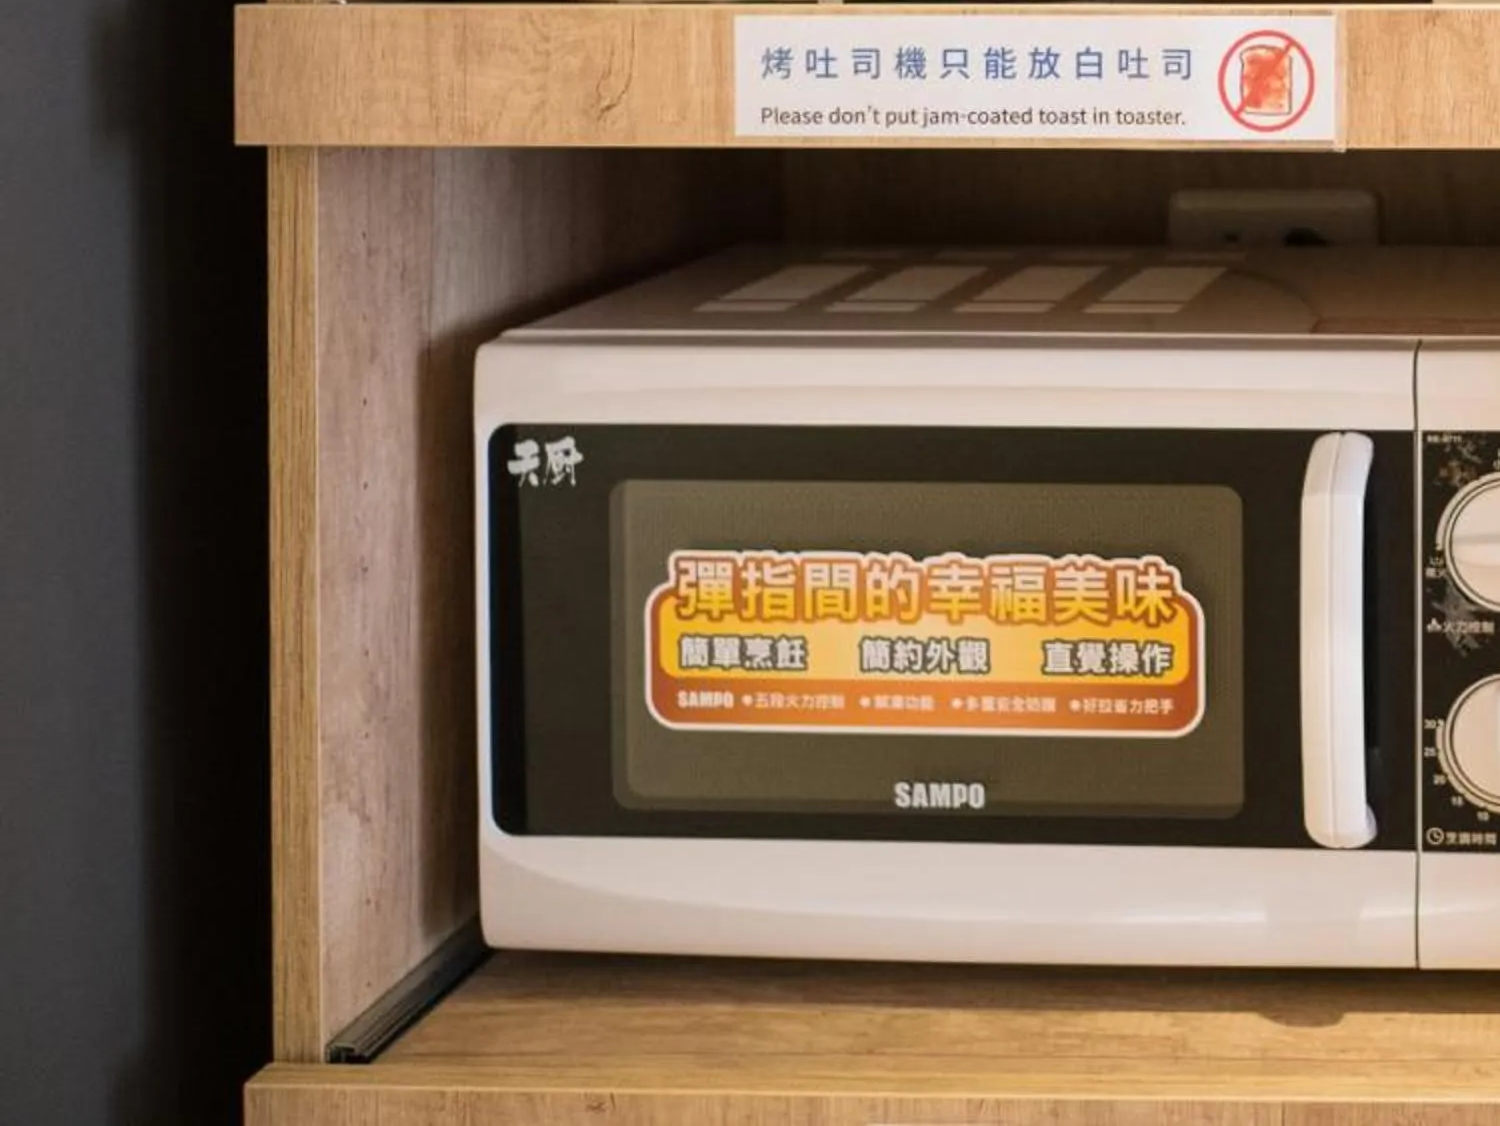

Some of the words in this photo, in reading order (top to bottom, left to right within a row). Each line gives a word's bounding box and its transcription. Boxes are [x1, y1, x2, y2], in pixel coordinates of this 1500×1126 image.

[761, 46, 1193, 81] 烤吐司機只能放白吐司
[761, 107, 823, 125] Please
[828, 105, 880, 125] don't
[885, 110, 917, 128] put
[922, 107, 1033, 128] jam-coated
[1039, 109, 1088, 125] toast
[1093, 107, 1111, 125] in
[1116, 109, 1186, 125] toaster.
[677, 558, 1177, 625] 彈指間的幸福美味
[678, 636, 806, 670] 簡單烹飪
[860, 637, 989, 673] 簡約外觀
[1042, 640, 1174, 675] 直覺操作
[677, 691, 734, 708] SAMPO
[894, 782, 986, 809] SAMPO
